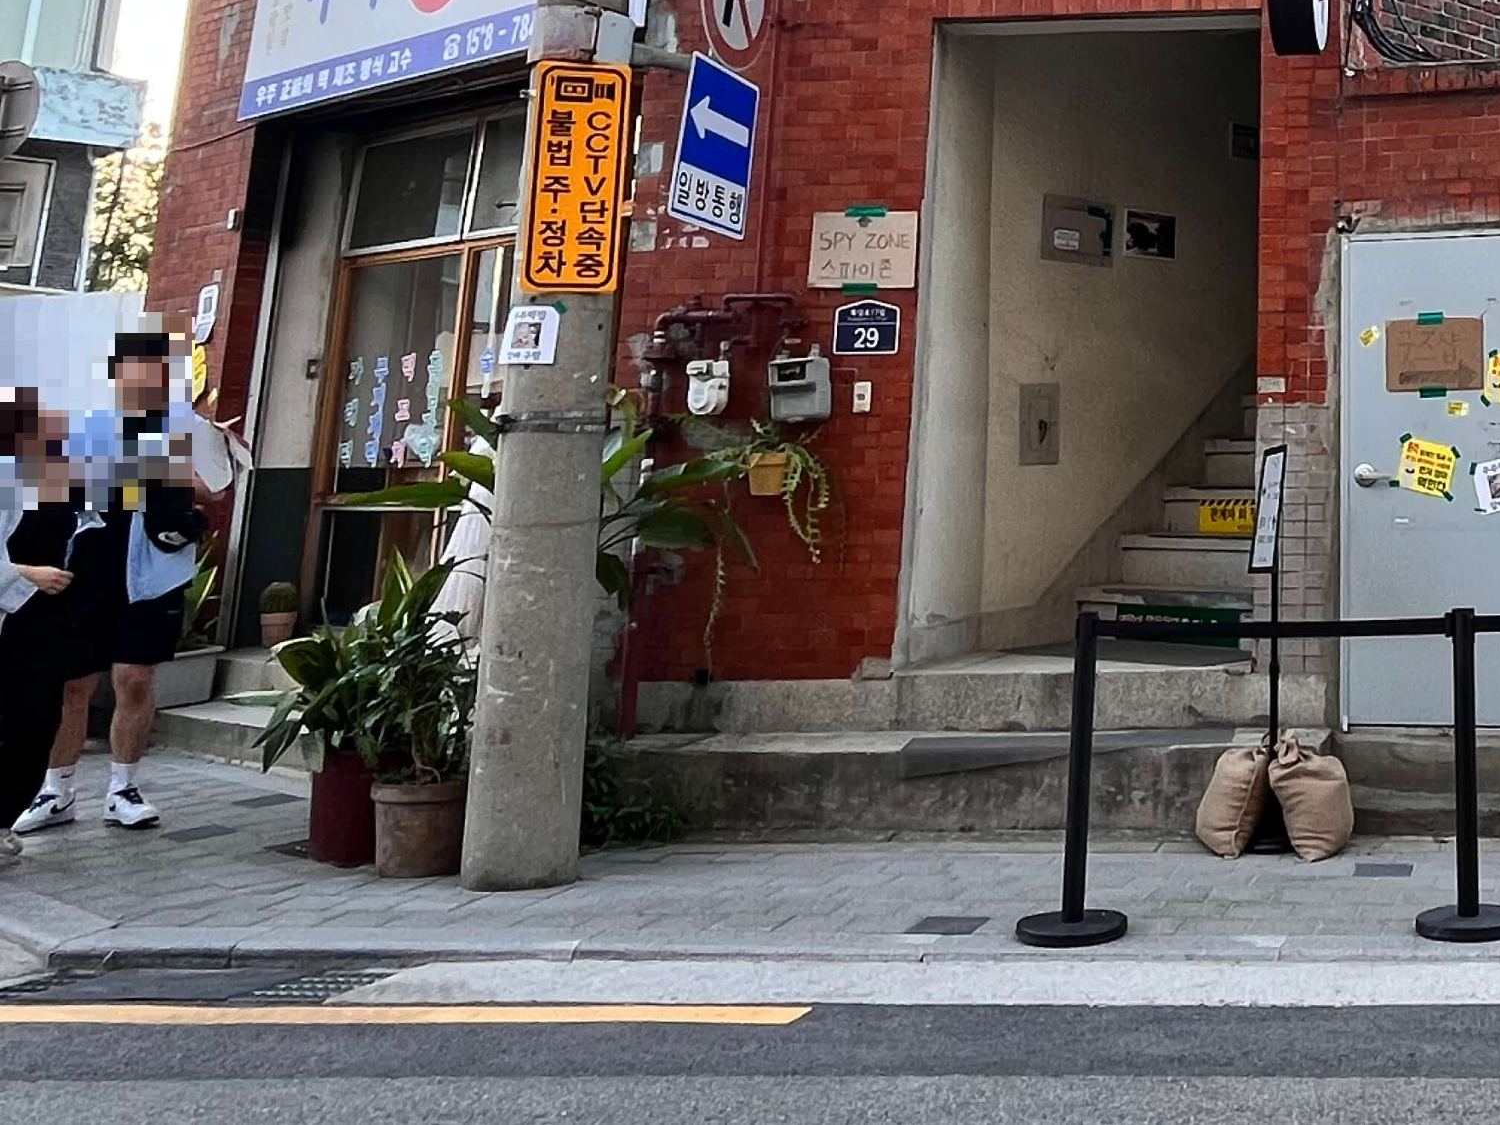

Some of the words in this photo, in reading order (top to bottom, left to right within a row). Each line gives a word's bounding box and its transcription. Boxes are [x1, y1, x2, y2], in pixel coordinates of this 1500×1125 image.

[255, 82, 277, 107] 우주
[332, 63, 356, 87] 제조
[359, 55, 384, 80] 방식
[387, 48, 412, 72] 고수
[547, 109, 576, 166] 불법
[678, 171, 742, 224] 일방통행
[819, 232, 856, 250] SPY
[865, 233, 910, 249] ZONE
[853, 327, 879, 348] 29
